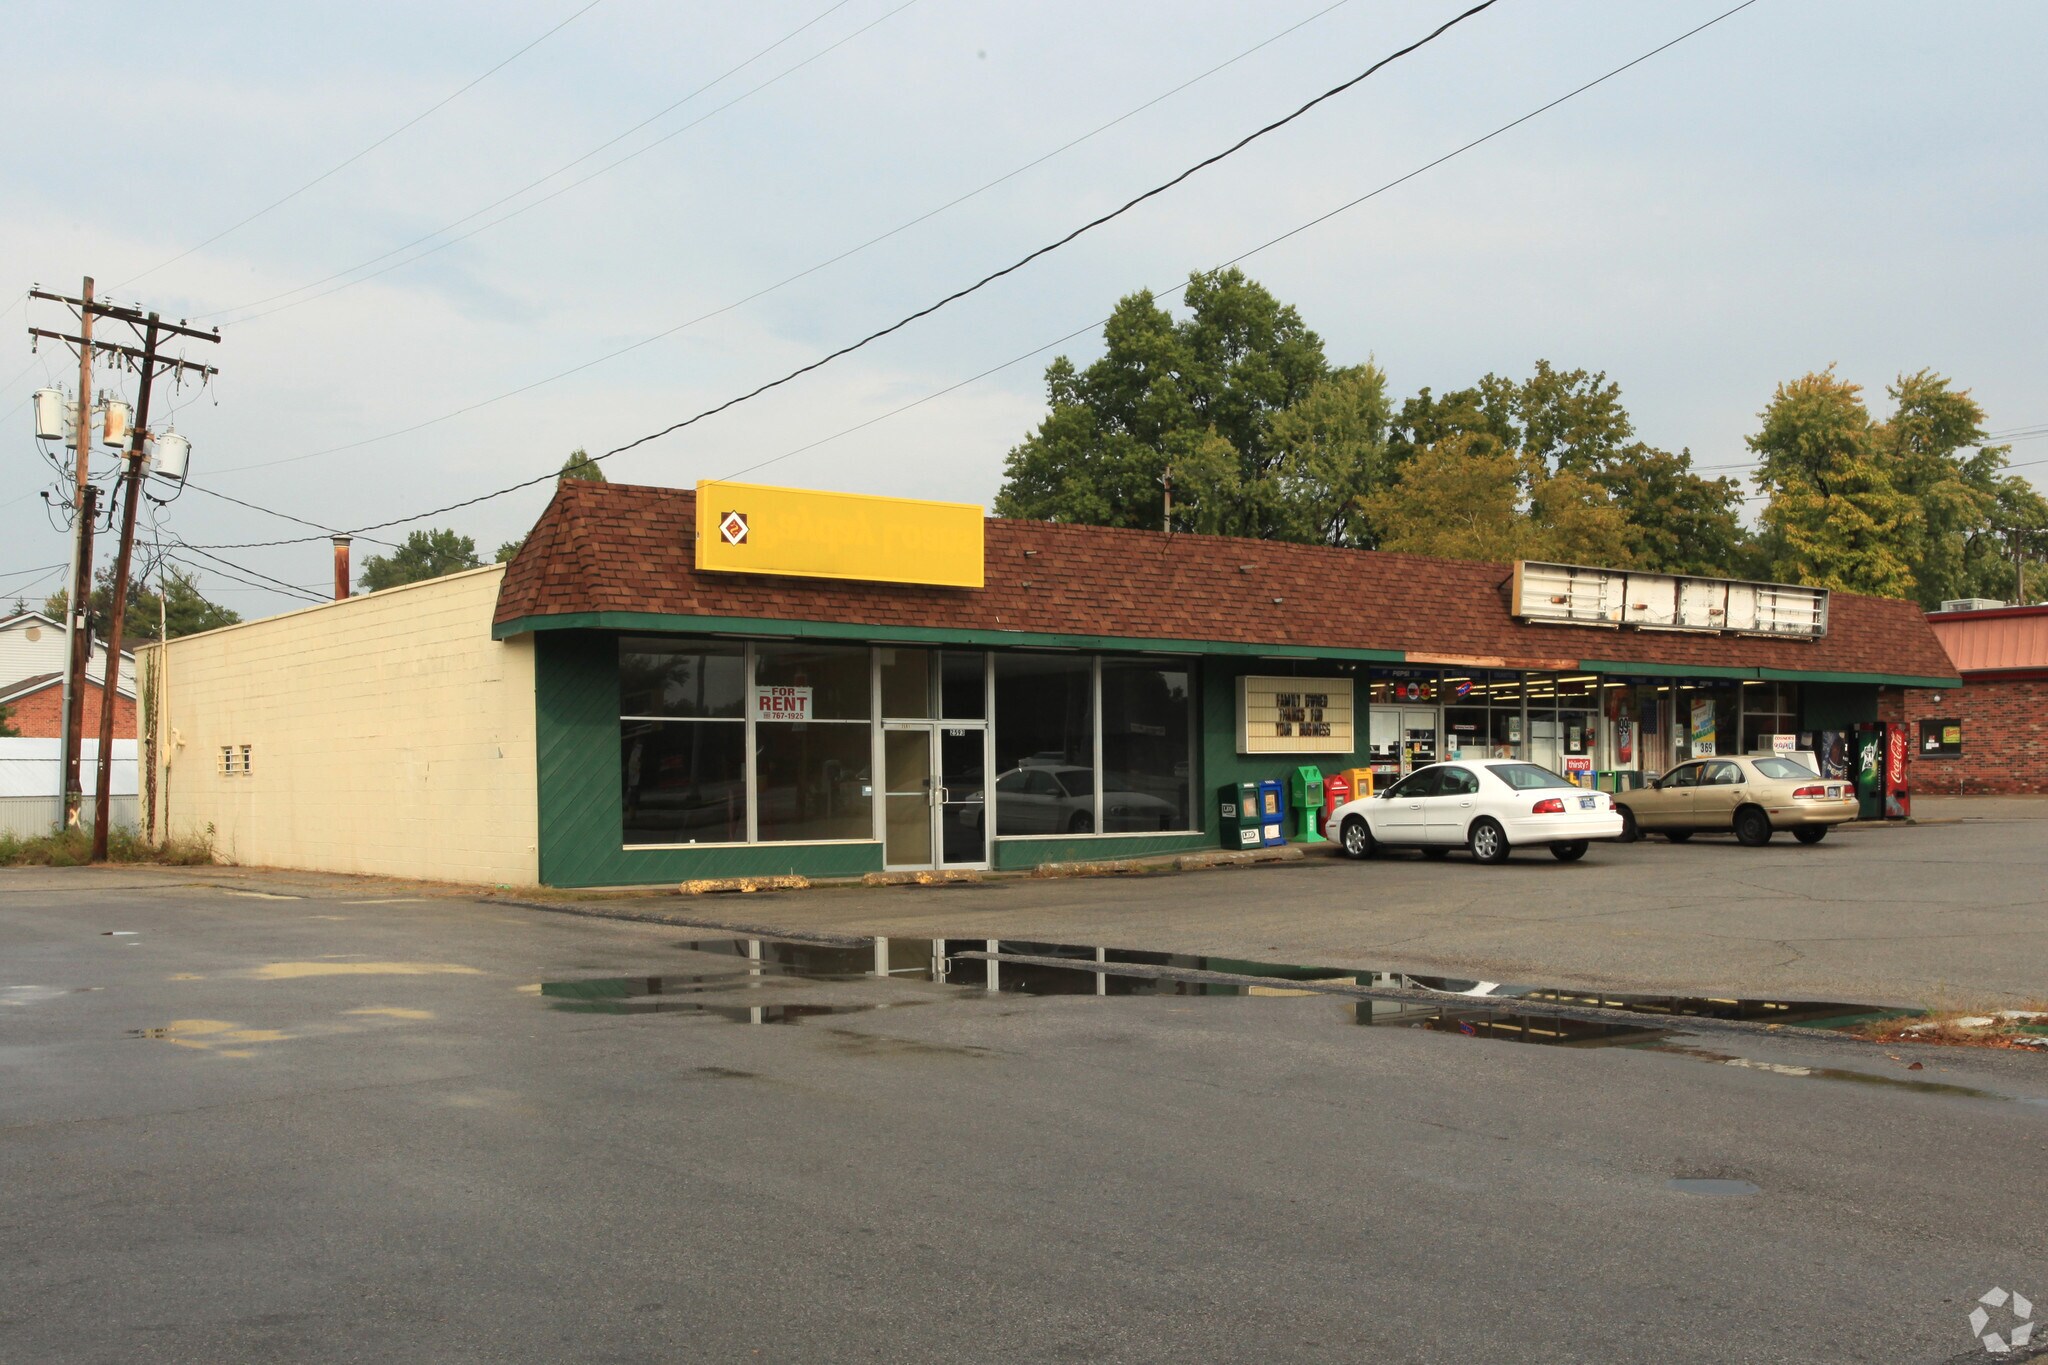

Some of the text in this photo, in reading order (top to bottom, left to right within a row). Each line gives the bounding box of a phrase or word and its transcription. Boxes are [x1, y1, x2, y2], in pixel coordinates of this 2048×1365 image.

[772, 687, 795, 696] FOR
[759, 695, 807, 711] RENT
[1276, 693, 1328, 708] FAMILY OWNED
[1279, 708, 1323, 722] THANKS FOR
[1276, 723, 1331, 737] YOUR BUSINESS
[1890, 731, 1903, 784] Coca-Cola
[1568, 760, 1589, 770] thirsty?
